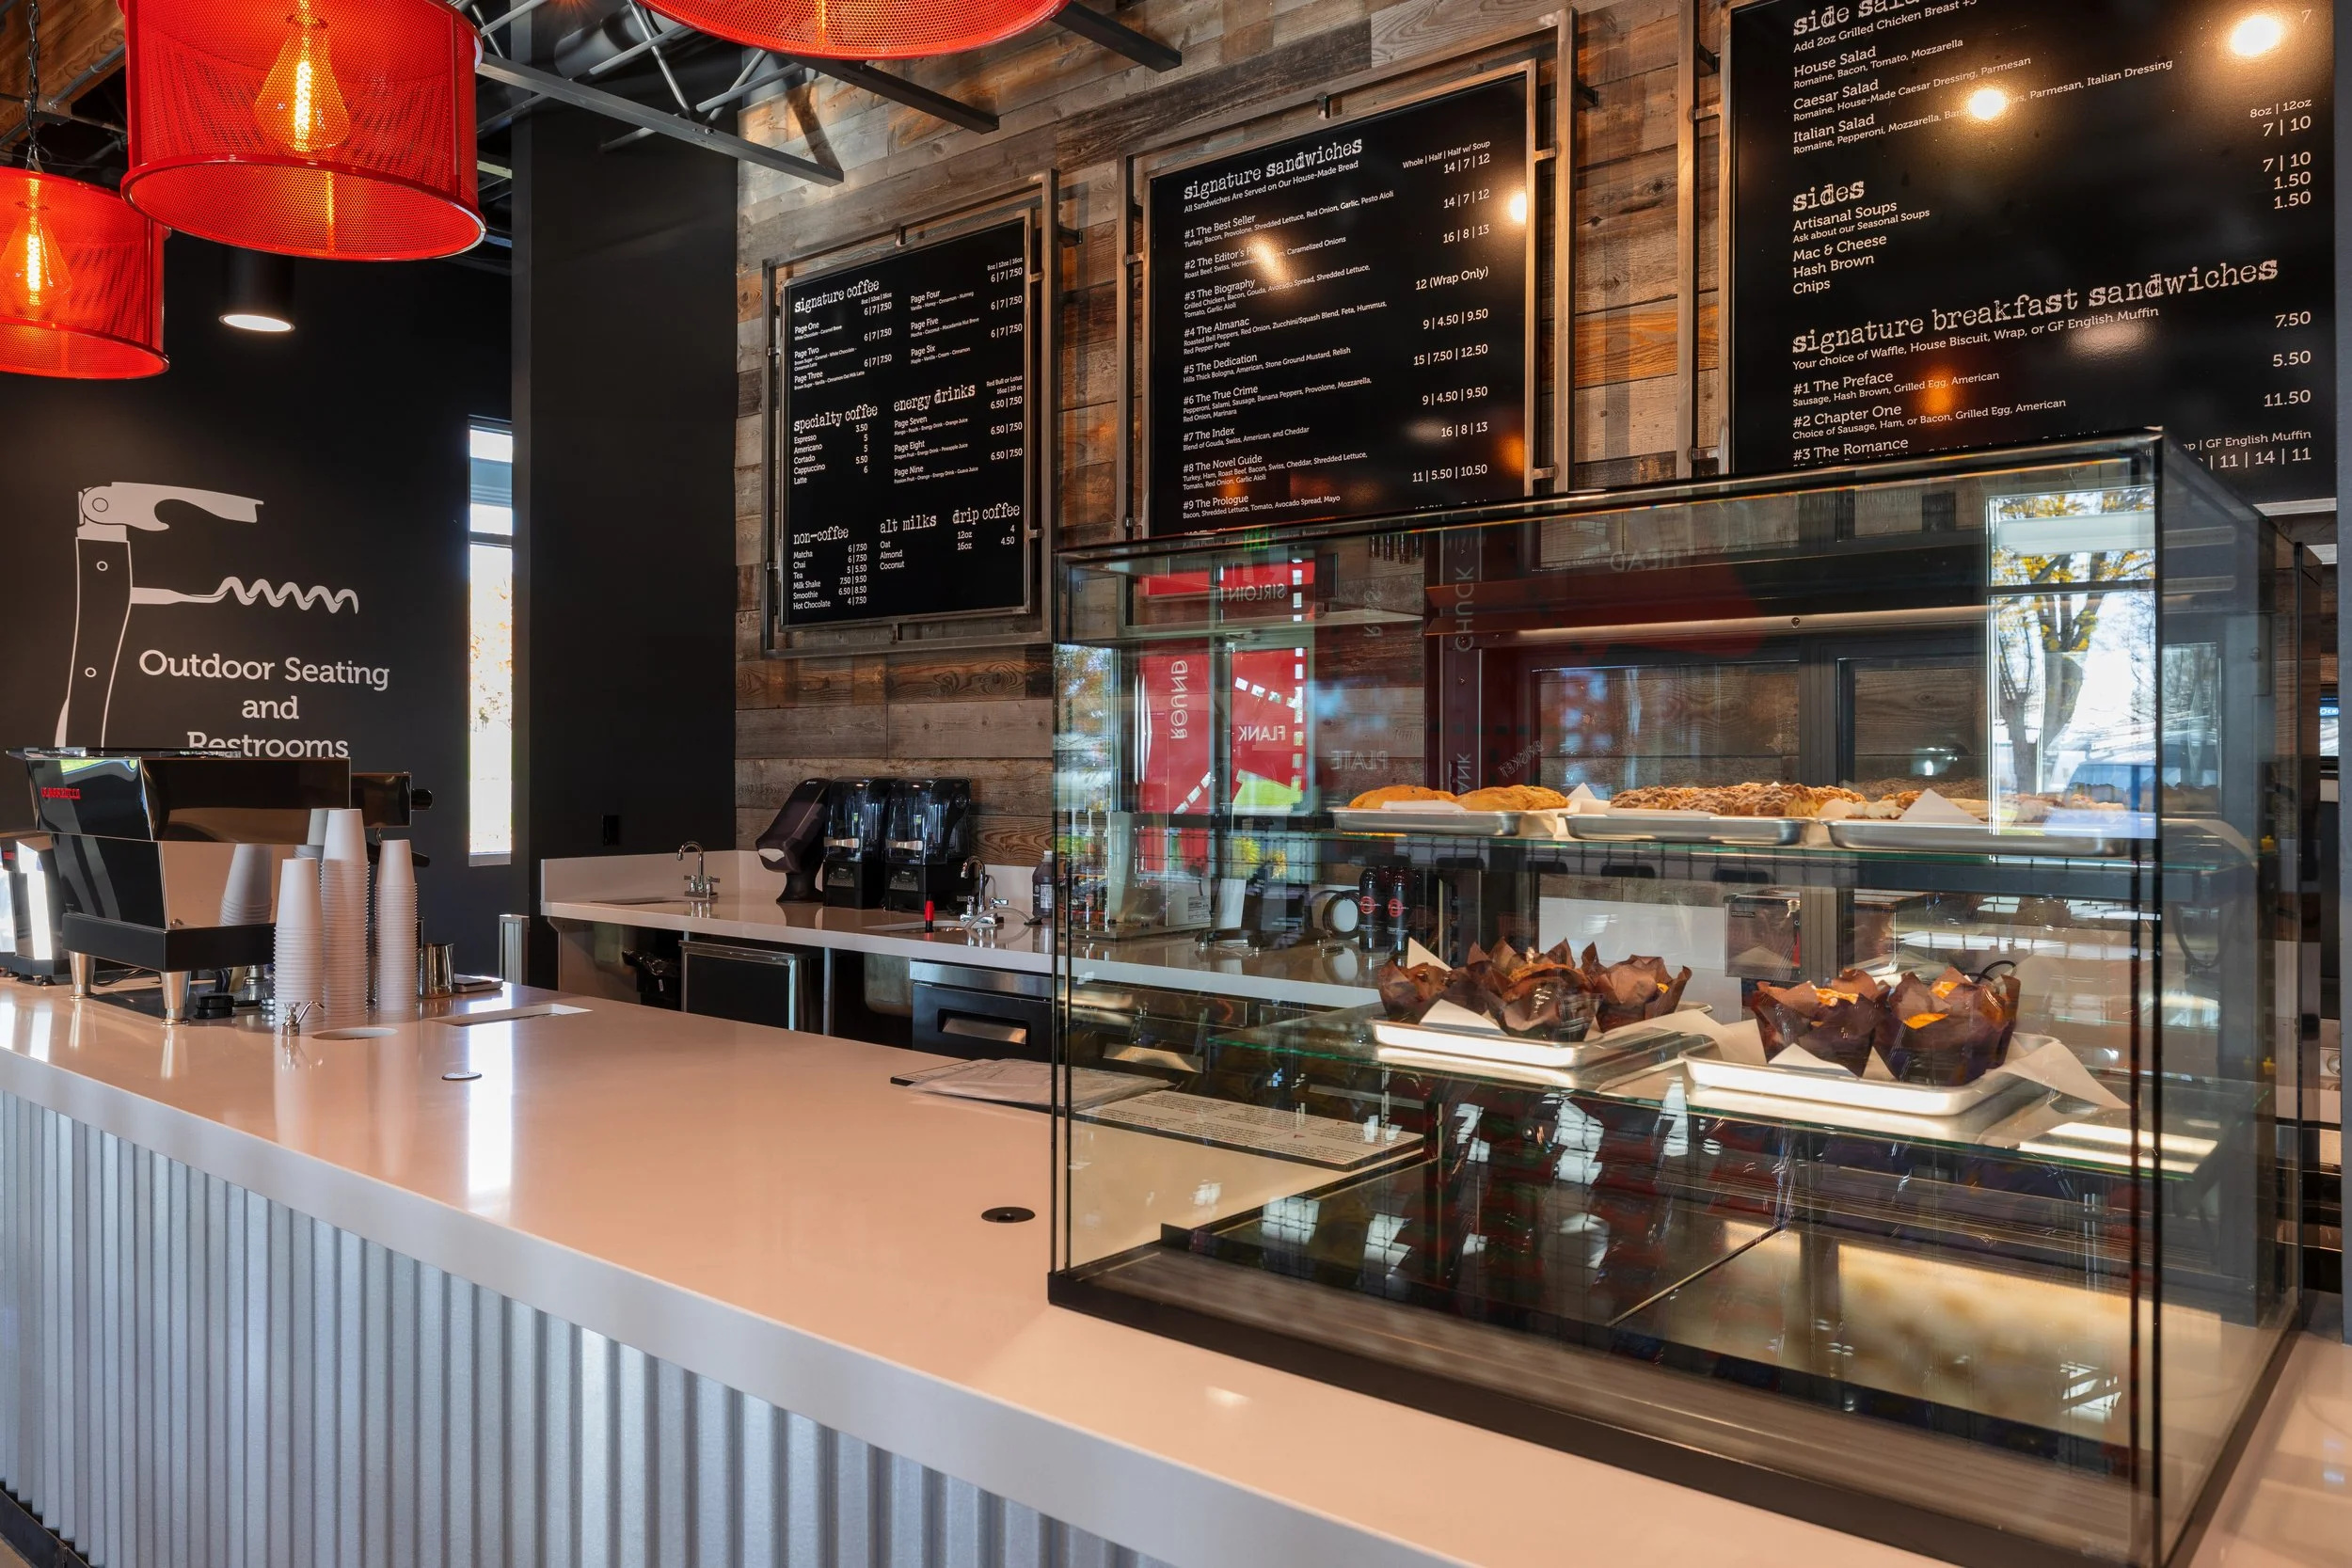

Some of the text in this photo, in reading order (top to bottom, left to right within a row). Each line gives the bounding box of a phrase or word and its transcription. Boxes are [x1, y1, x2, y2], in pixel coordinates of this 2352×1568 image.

[1793, 6, 1849, 36] side
[1793, 38, 1814, 52] Add
[1817, 35, 1836, 46] 2oz
[1838, 23, 1873, 40] Grilled
[1876, 12, 1921, 30] Chicken
[1924, 0, 1959, 17] Breast
[2299, 8, 2313, 23] 7
[1793, 45, 1876, 76] House Salad
[1793, 39, 1963, 88] Romaine, Bacon, Tomato, Mozzarella
[1793, 58, 2030, 121] Romaine, House-Made Caesar Dressing, Parmesan
[2029, 61, 2172, 99] Parmesan, Italian Dressing
[1793, 78, 1878, 109] Caesar Salad
[2249, 100, 2312, 118] 8oz 12oz
[1793, 113, 1874, 143] Italian Salad
[1793, 114, 1941, 154] Romaine, Pepperoni, Mozzarella,
[2263, 116, 2311, 136] 7 10
[1184, 139, 1362, 199] signature sandwiches
[2263, 151, 2311, 172] 7 10
[1184, 202, 1192, 213] All
[1193, 195, 1231, 211] Sandwiches
[1232, 192, 1243, 200] Are
[1244, 183, 1266, 198] Served
[1278, 180, 1291, 188] Our
[1292, 166, 1336, 184] House-Made
[1338, 160, 1358, 173] Bread
[2274, 170, 2311, 190] 1.50
[1792, 181, 1865, 212] sides
[2274, 190, 2311, 209] 1.50
[1184, 214, 1255, 238] #1 The Best Seller
[1792, 203, 1897, 230] Artisanal Soups
[1792, 211, 1930, 243] Ask about our Seasonal Soups
[1792, 235, 1886, 261] Mac & Cheese
[1793, 254, 1874, 277] Hash Brown
[794, 279, 880, 312] signature coffee
[1792, 278, 1830, 293] Chips
[1792, 259, 2278, 354] signature breakfast sandwiches
[1184, 319, 1249, 337] #4 The Almanac
[2275, 310, 2311, 328] 7.50
[1792, 307, 2158, 370] Your choice of Waffle, House Biscuit, Wrap, or GF English Muffin
[2273, 350, 2311, 367] 5.50
[1184, 385, 1258, 404] #6 The True Crime
[1792, 372, 1999, 406] Sausage, Hash Brown, Grilled Egg, American
[1793, 372, 1893, 394] #1 The Preface
[894, 384, 975, 411] energy drinks
[2264, 389, 2311, 407] 11.50
[793, 404, 878, 434] specialty coffee
[1792, 428, 1823, 439] Choice
[1825, 425, 1836, 436] of
[1837, 422, 1877, 434] Sausage,
[1880, 419, 1904, 429] Ham,
[1919, 414, 1952, 424] Bacon,
[1955, 406, 1988, 420] Grilled
[1991, 405, 2012, 417] Egg,
[2015, 400, 2066, 412] American
[1793, 404, 1901, 427] #2 Chapter One
[793, 444, 822, 454] Americano
[794, 435, 817, 445] Espresso
[1792, 446, 1810, 460] #3
[1813, 444, 1839, 458] The
[1843, 438, 1908, 454] Romance
[2205, 436, 2221, 448] GF
[2224, 433, 2268, 448] English
[2271, 429, 2311, 442] Muffin
[793, 454, 815, 464] Cortado
[2219, 447, 2311, 467] 11 14 11
[793, 463, 825, 475] Cappuccino
[793, 476, 807, 484] Latte
[880, 514, 937, 533] alt milks
[952, 502, 1020, 526] drip coffee
[793, 526, 849, 545] non-coffee
[957, 531, 972, 539] 12oz
[957, 542, 972, 550] 16oz
[880, 549, 902, 559] Almond
[880, 561, 904, 570] Coconut
[138, 649, 389, 691] Outdoor Seating
[242, 696, 299, 720] and
